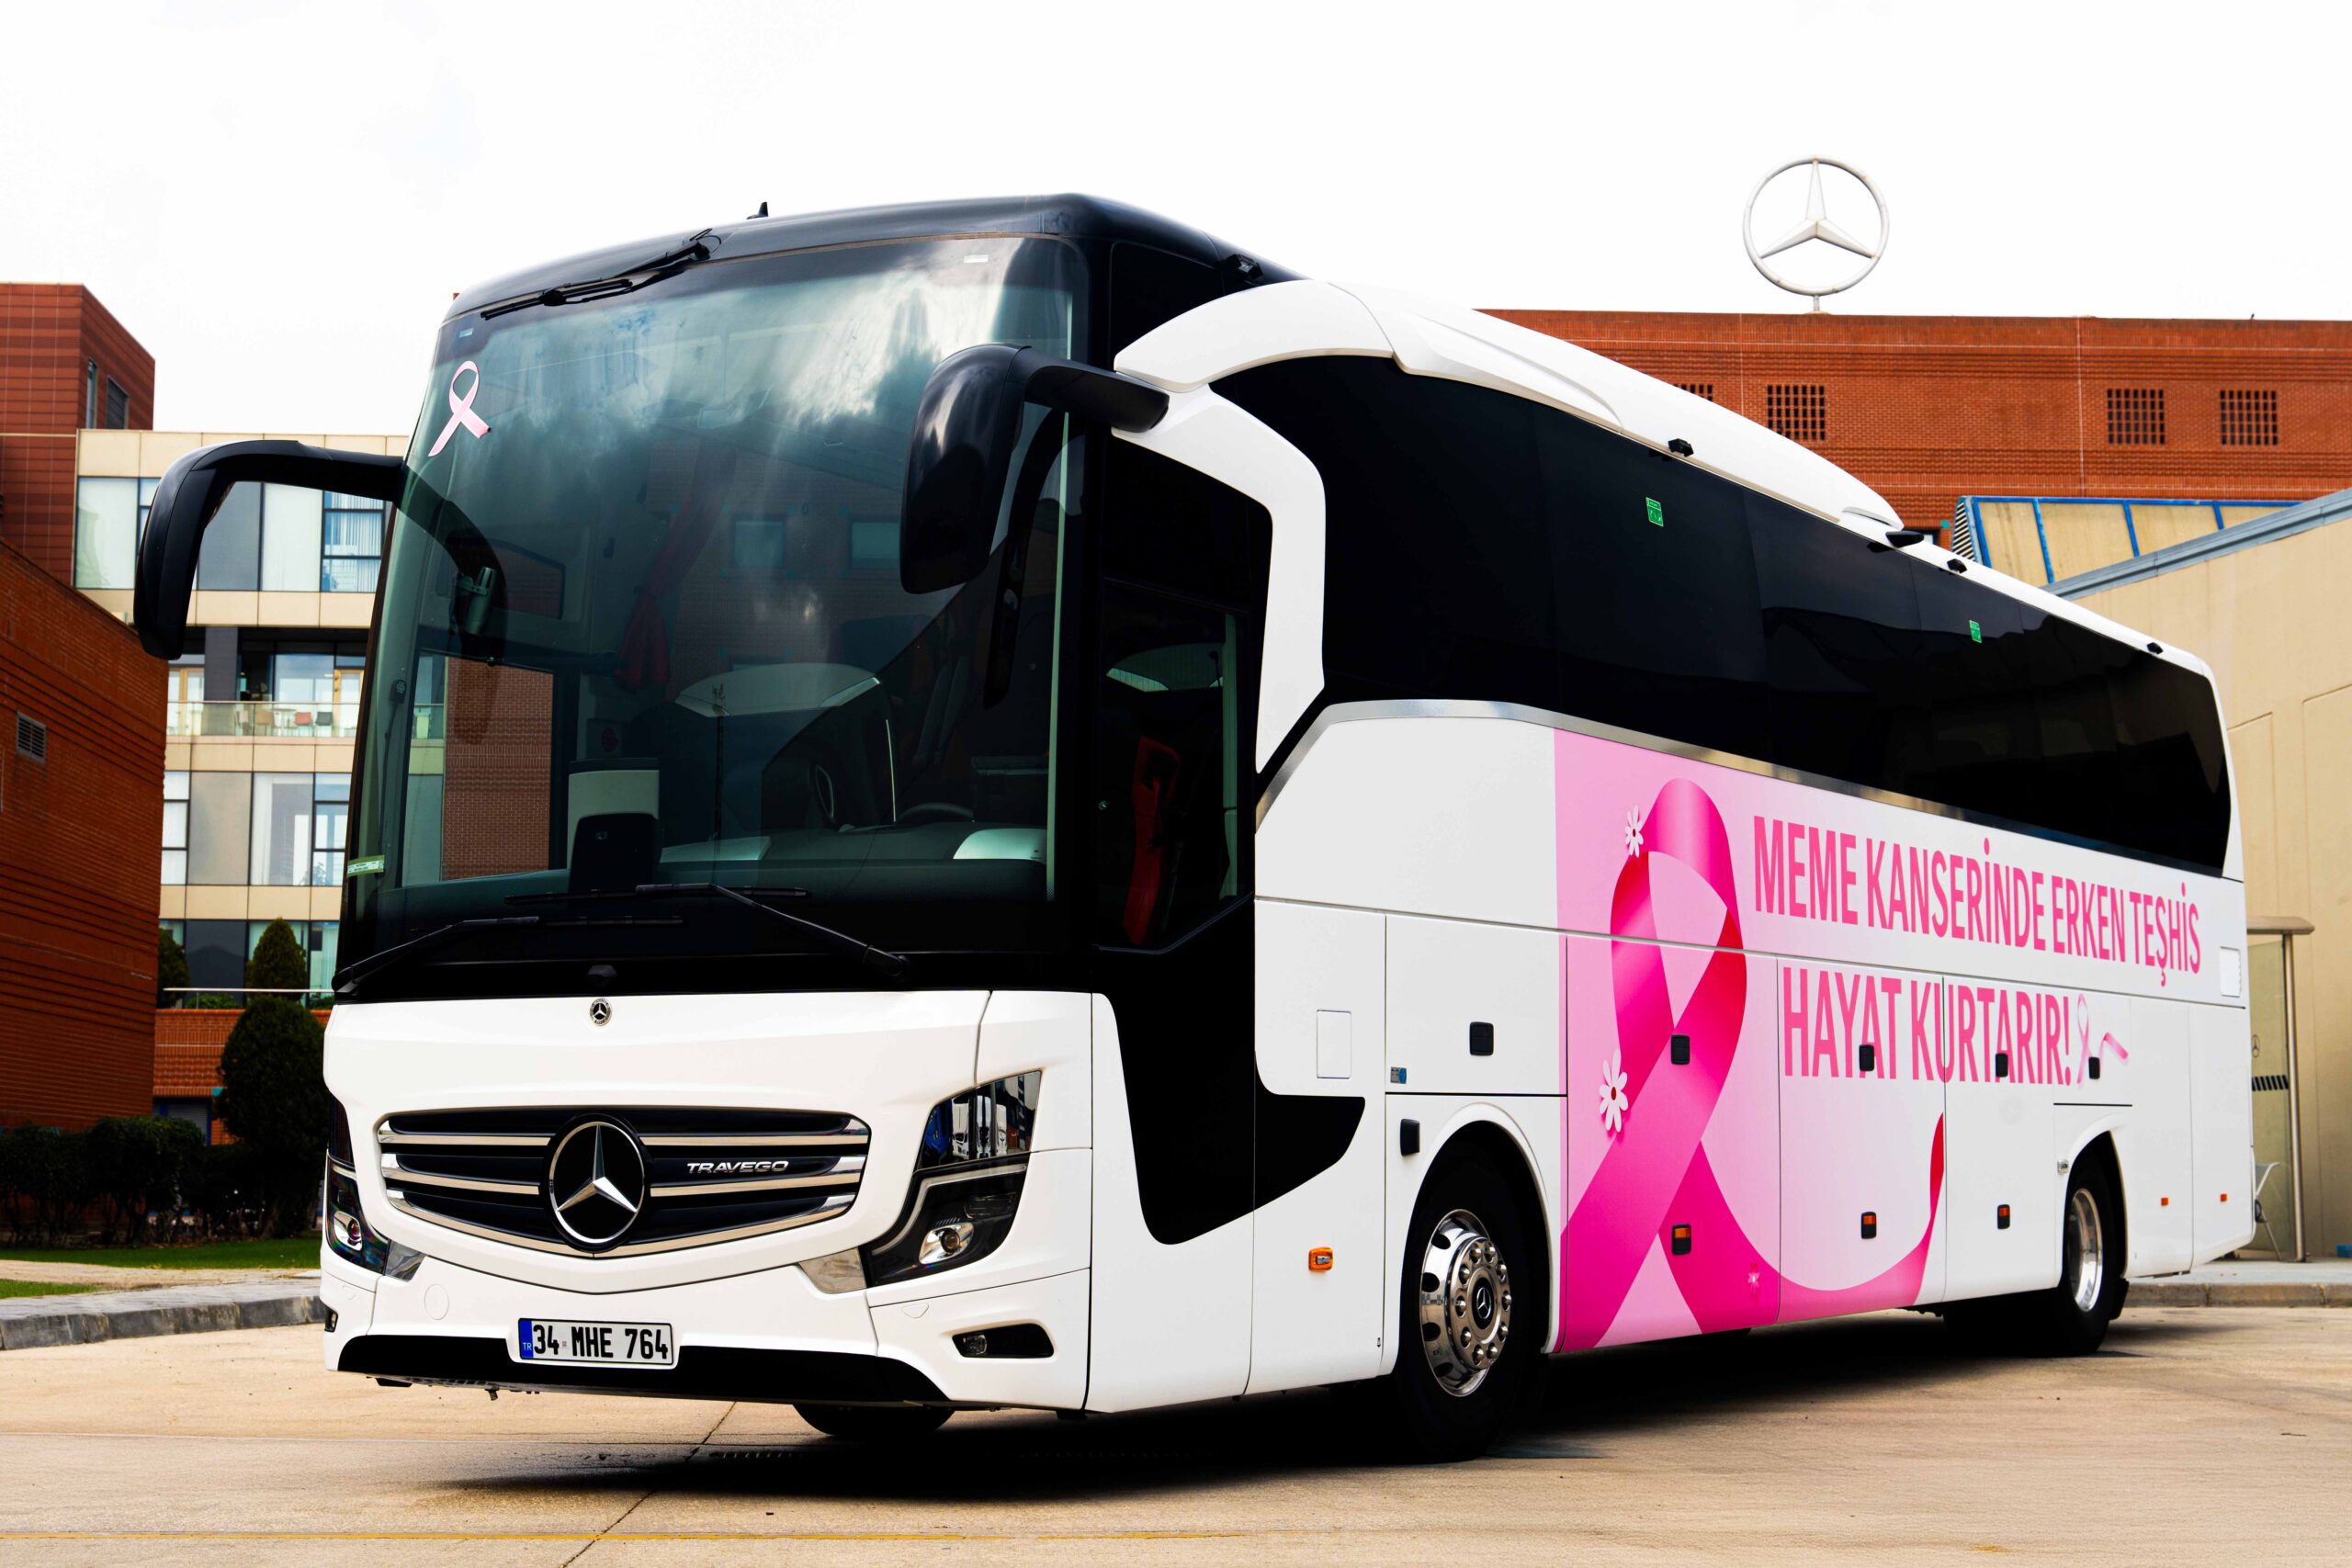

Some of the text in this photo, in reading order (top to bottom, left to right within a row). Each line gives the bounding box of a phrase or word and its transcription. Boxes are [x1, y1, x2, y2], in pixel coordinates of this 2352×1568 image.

[1753, 815, 2201, 987] MEME KANSERİNDE ERKEN TEŞHİS
[1783, 966, 2072, 1087] HAYAT KURTARIR!
[686, 1160, 789, 1174] TRAVEGO
[522, 1342, 532, 1351] TR
[533, 1325, 669, 1359] 34 MHE 764
